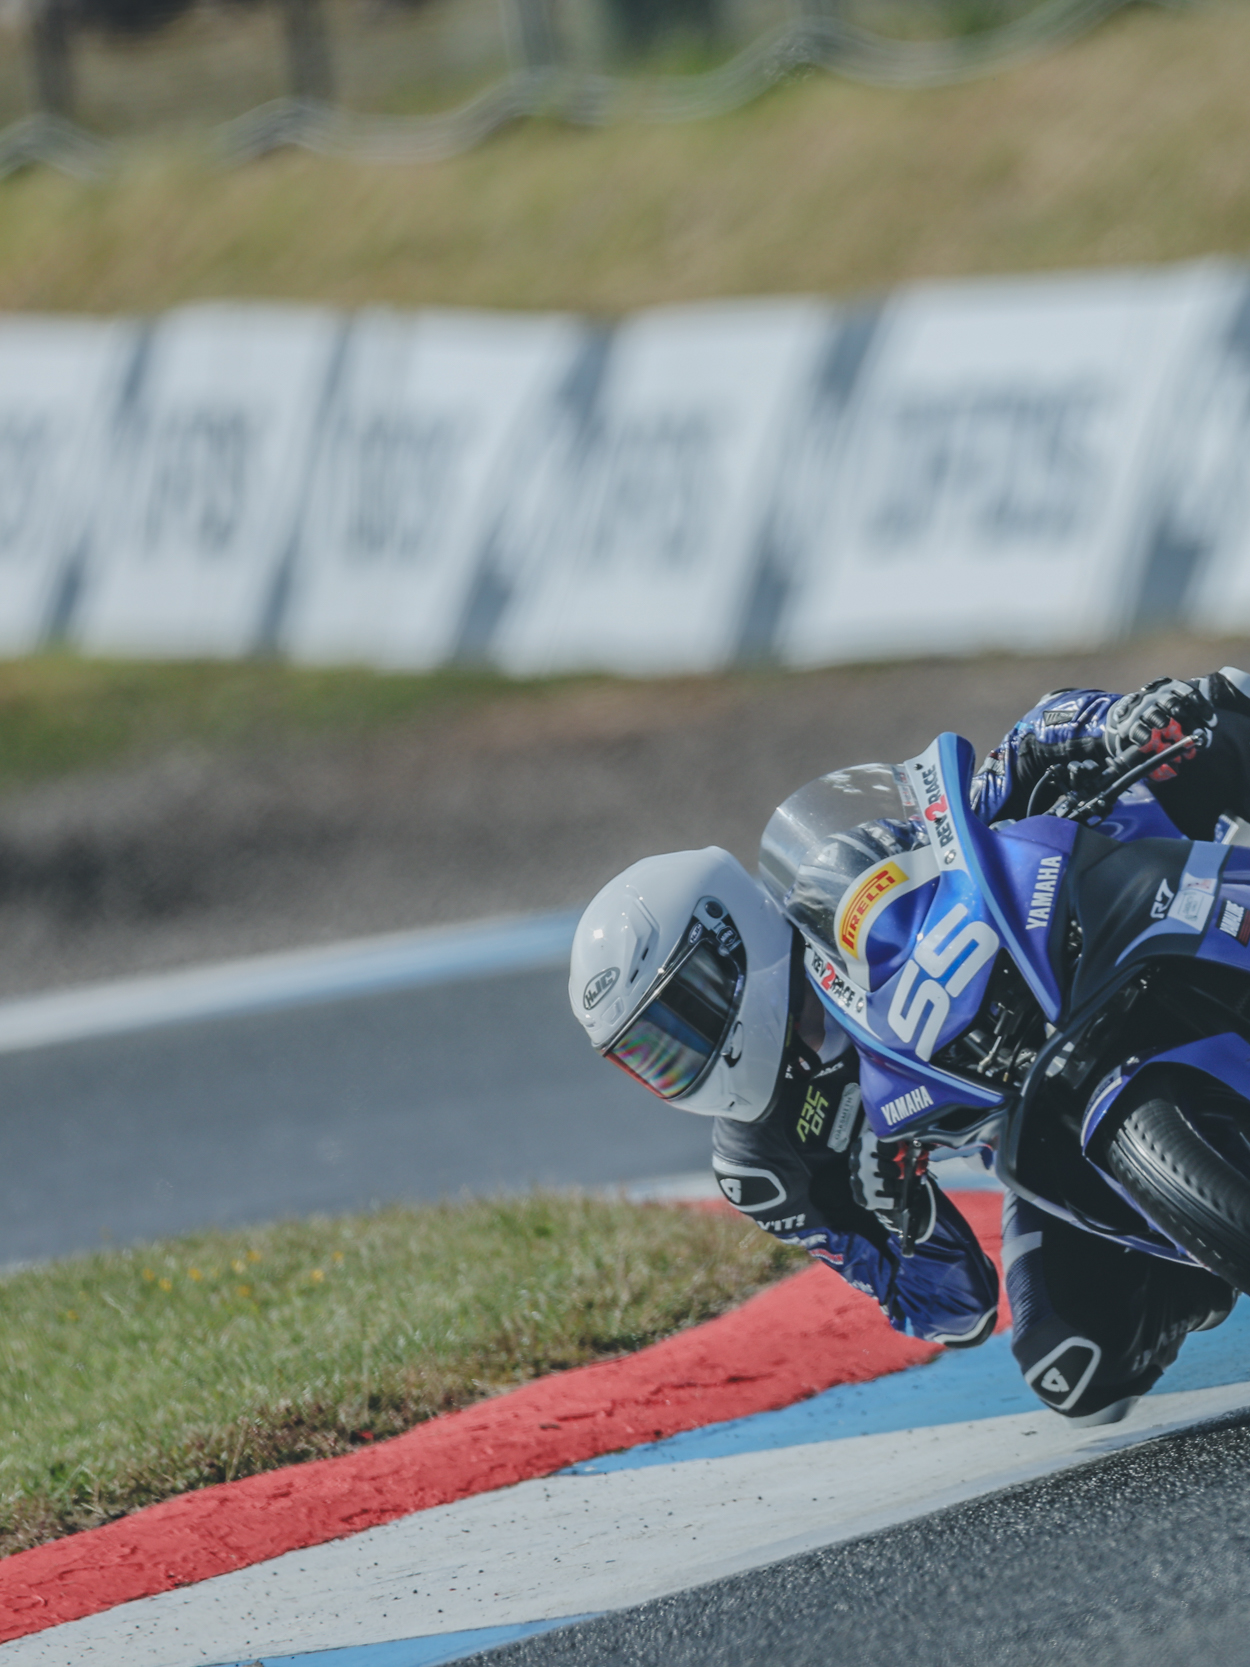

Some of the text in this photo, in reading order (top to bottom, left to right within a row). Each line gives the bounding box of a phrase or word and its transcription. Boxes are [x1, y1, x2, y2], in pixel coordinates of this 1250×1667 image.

[841, 869, 896, 949] PIRELLI
[1026, 856, 1062, 930] YAMAHA
[1150, 878, 1174, 919] R7
[584, 970, 614, 1008] HJC
[887, 903, 1000, 1062] 55
[881, 1085, 933, 1126] YAMAHA
